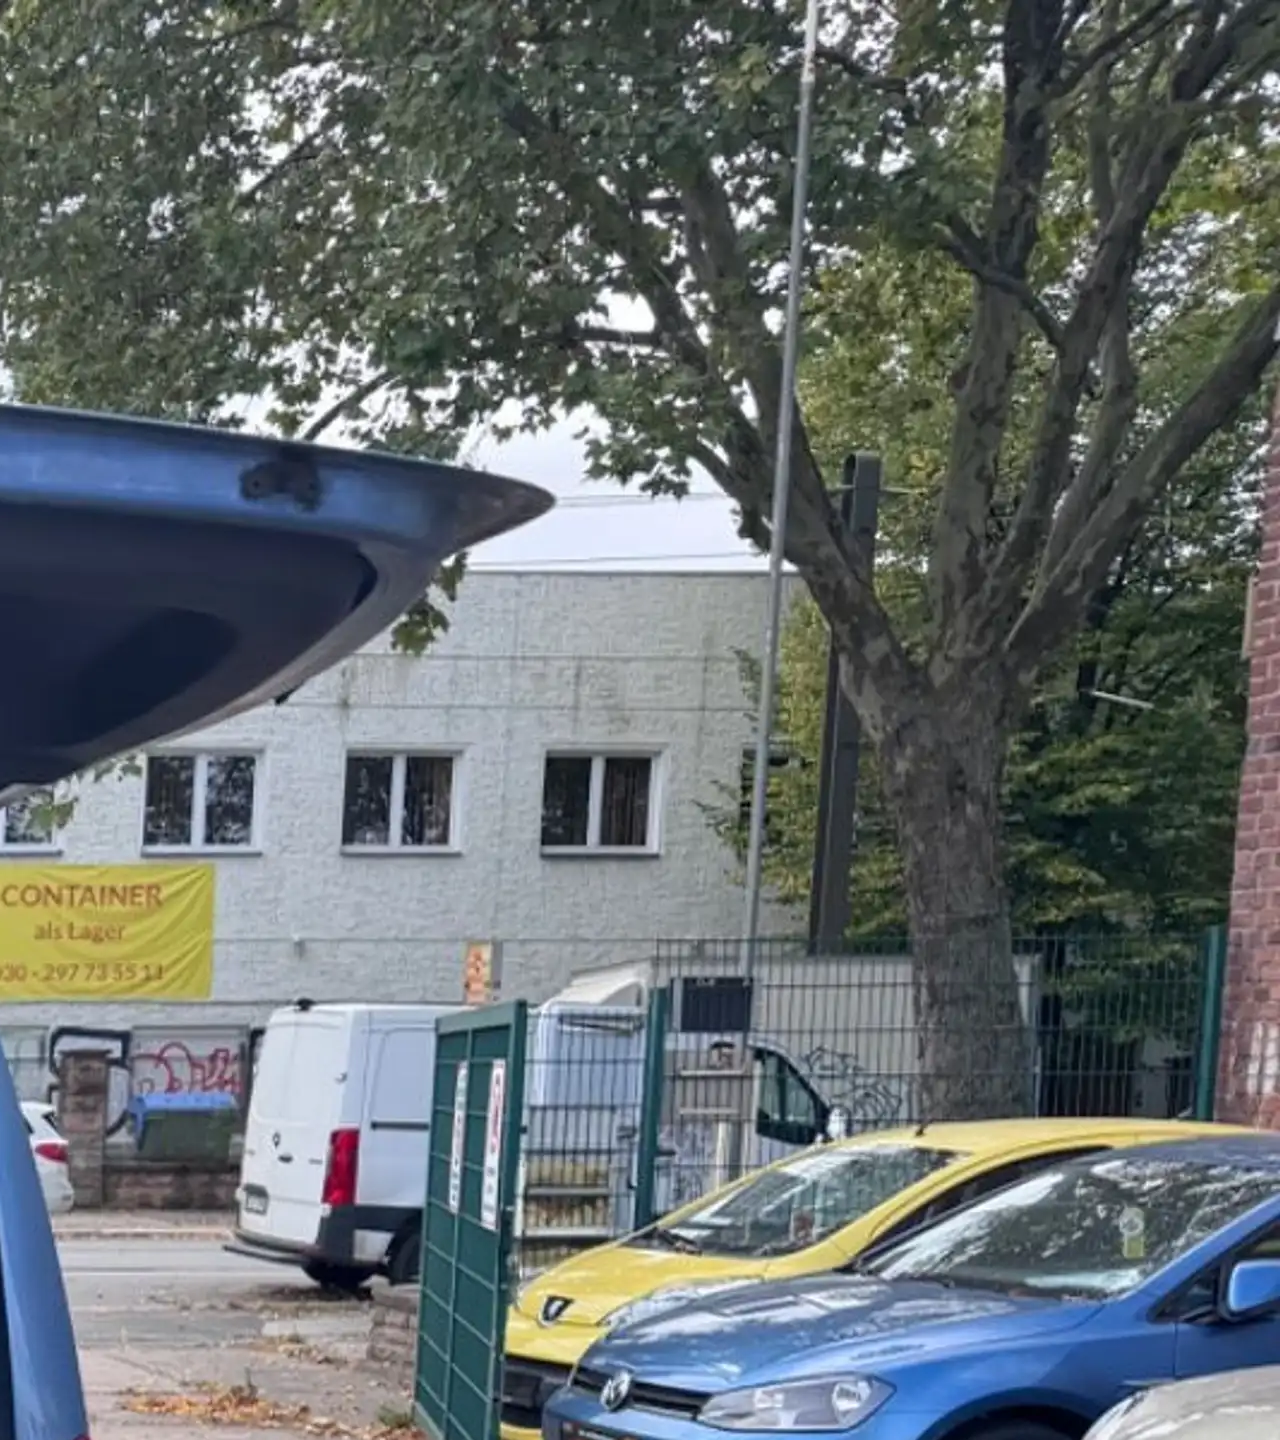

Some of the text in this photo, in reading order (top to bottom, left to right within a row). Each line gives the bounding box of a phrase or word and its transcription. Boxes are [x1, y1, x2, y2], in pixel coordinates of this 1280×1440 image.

[1, 883, 163, 908] CONTAINER
[34, 921, 125, 943] als Lager
[43, 963, 79, 981] 297
